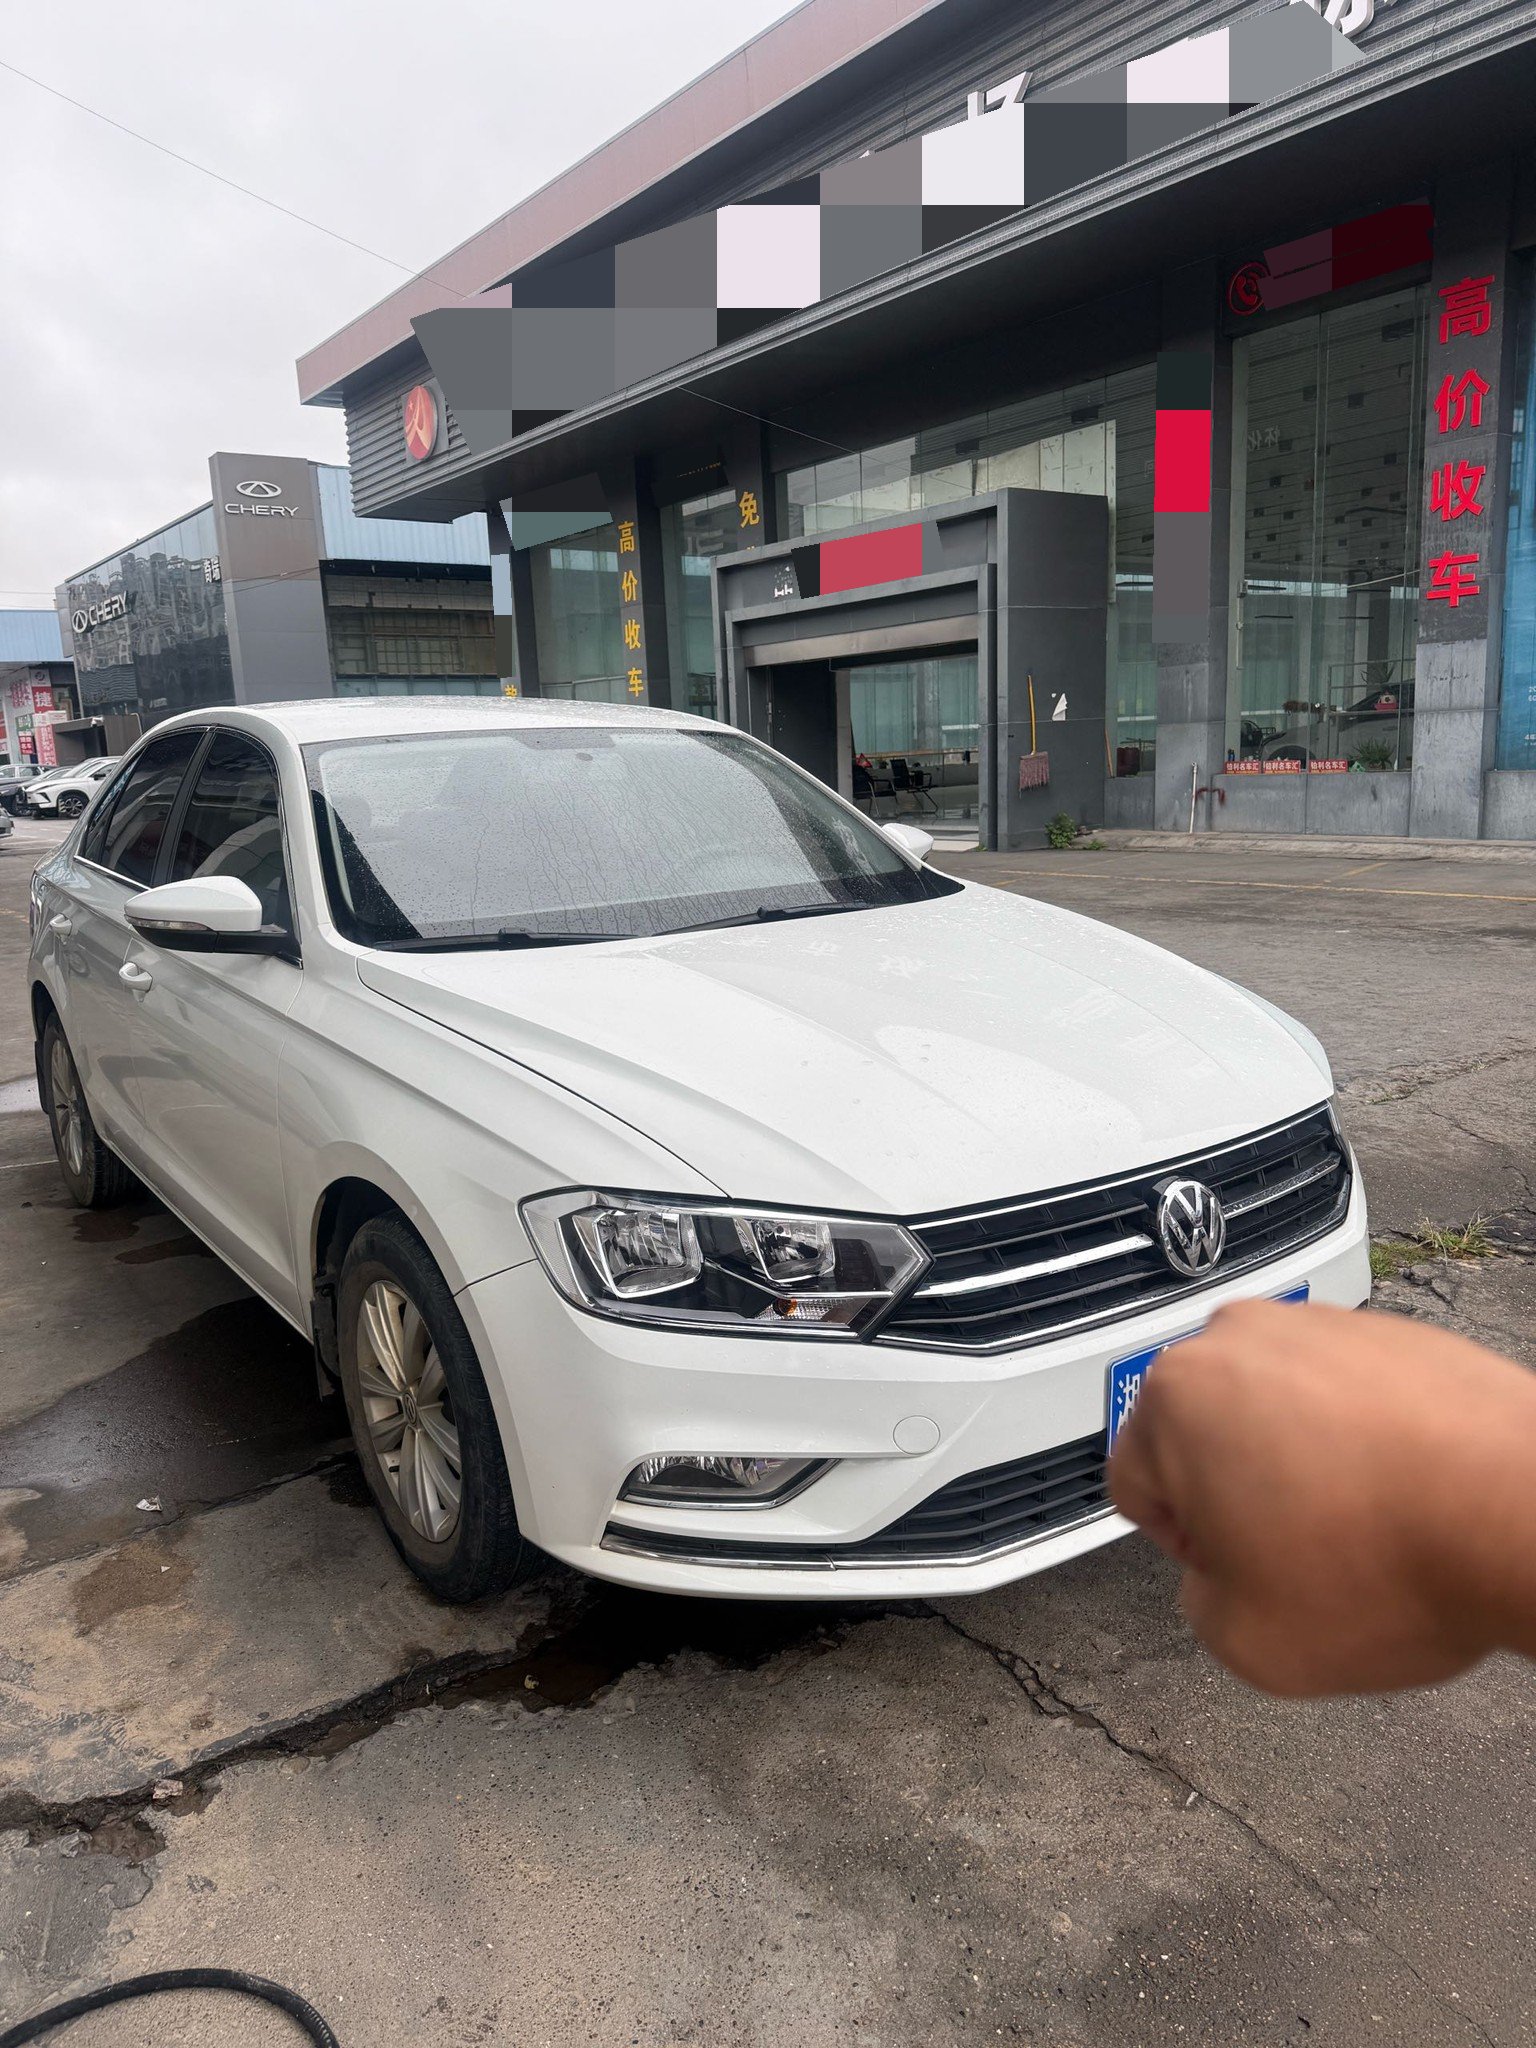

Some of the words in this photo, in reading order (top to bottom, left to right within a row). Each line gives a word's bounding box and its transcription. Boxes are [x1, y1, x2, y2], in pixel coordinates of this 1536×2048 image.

[1427, 275, 1495, 607] 高价收车
[224, 503, 299, 517] CHERY
[738, 491, 760, 529] 免
[89, 591, 127, 626] CHERY
[618, 520, 644, 698] 高价收车
